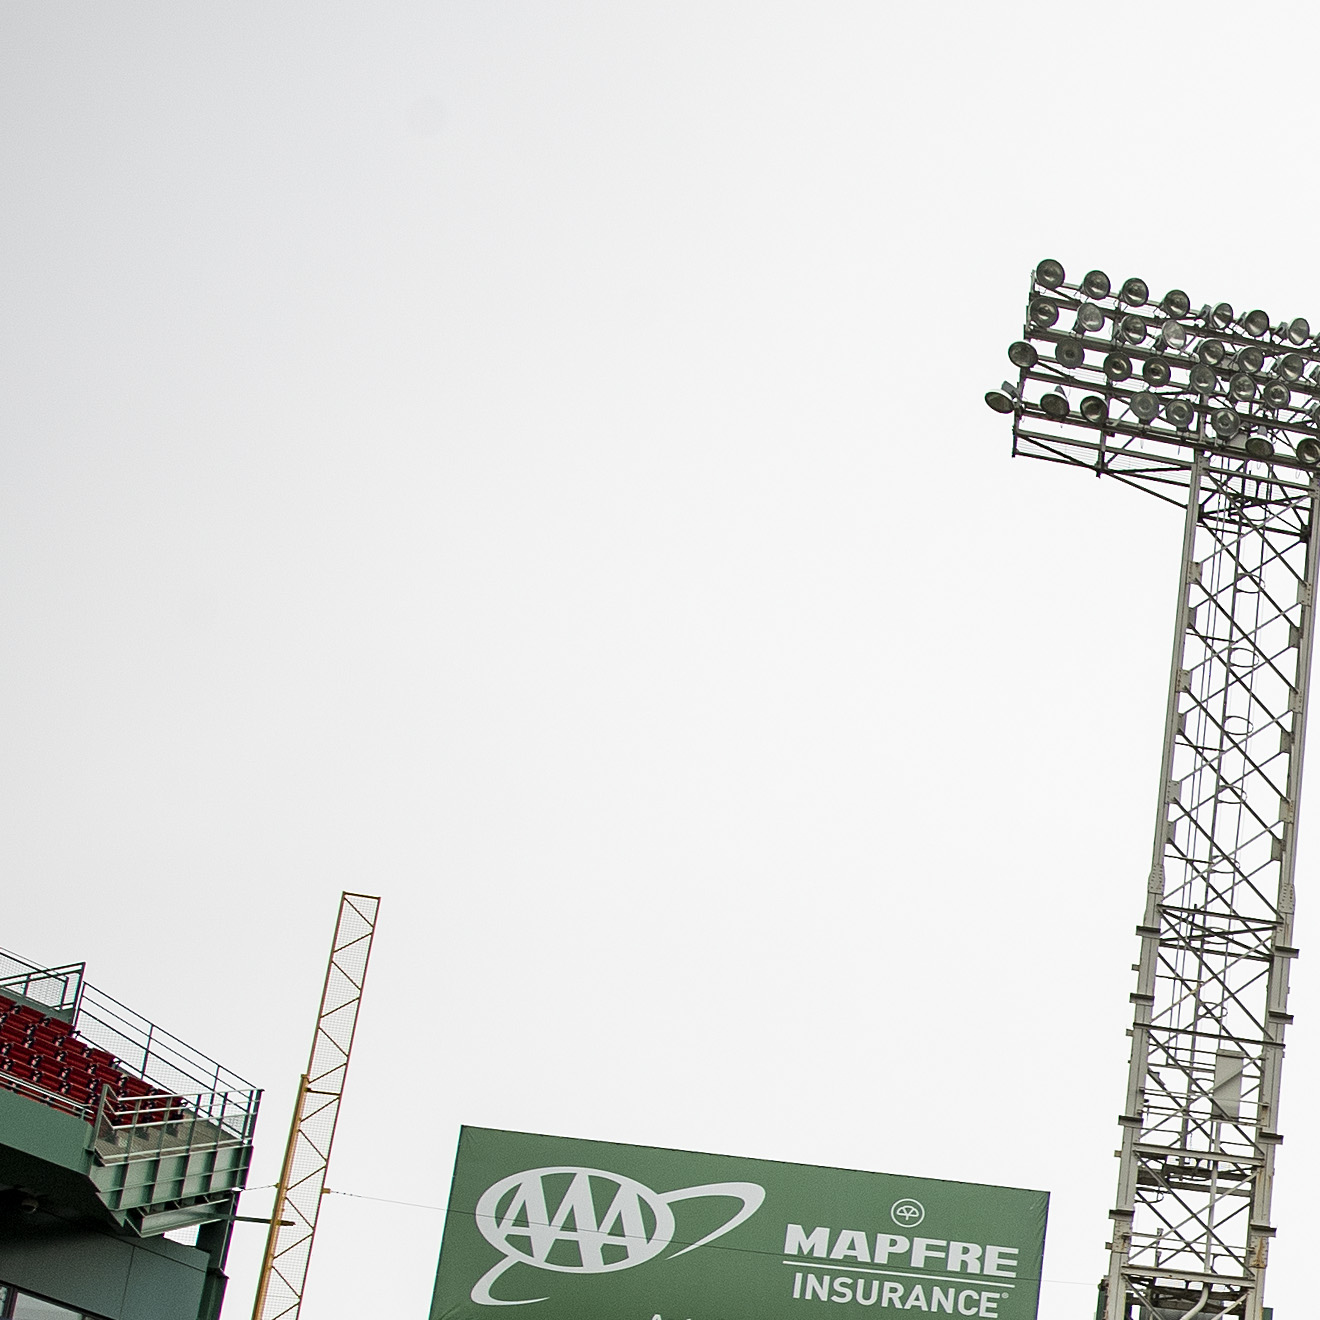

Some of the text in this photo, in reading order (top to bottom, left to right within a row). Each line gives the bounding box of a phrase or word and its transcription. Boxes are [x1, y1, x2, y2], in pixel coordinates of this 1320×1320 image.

[496, 1170, 650, 1270] AAA
[782, 1222, 1020, 1279] MAPFRE
[791, 1272, 1000, 1319] INSURANCE
